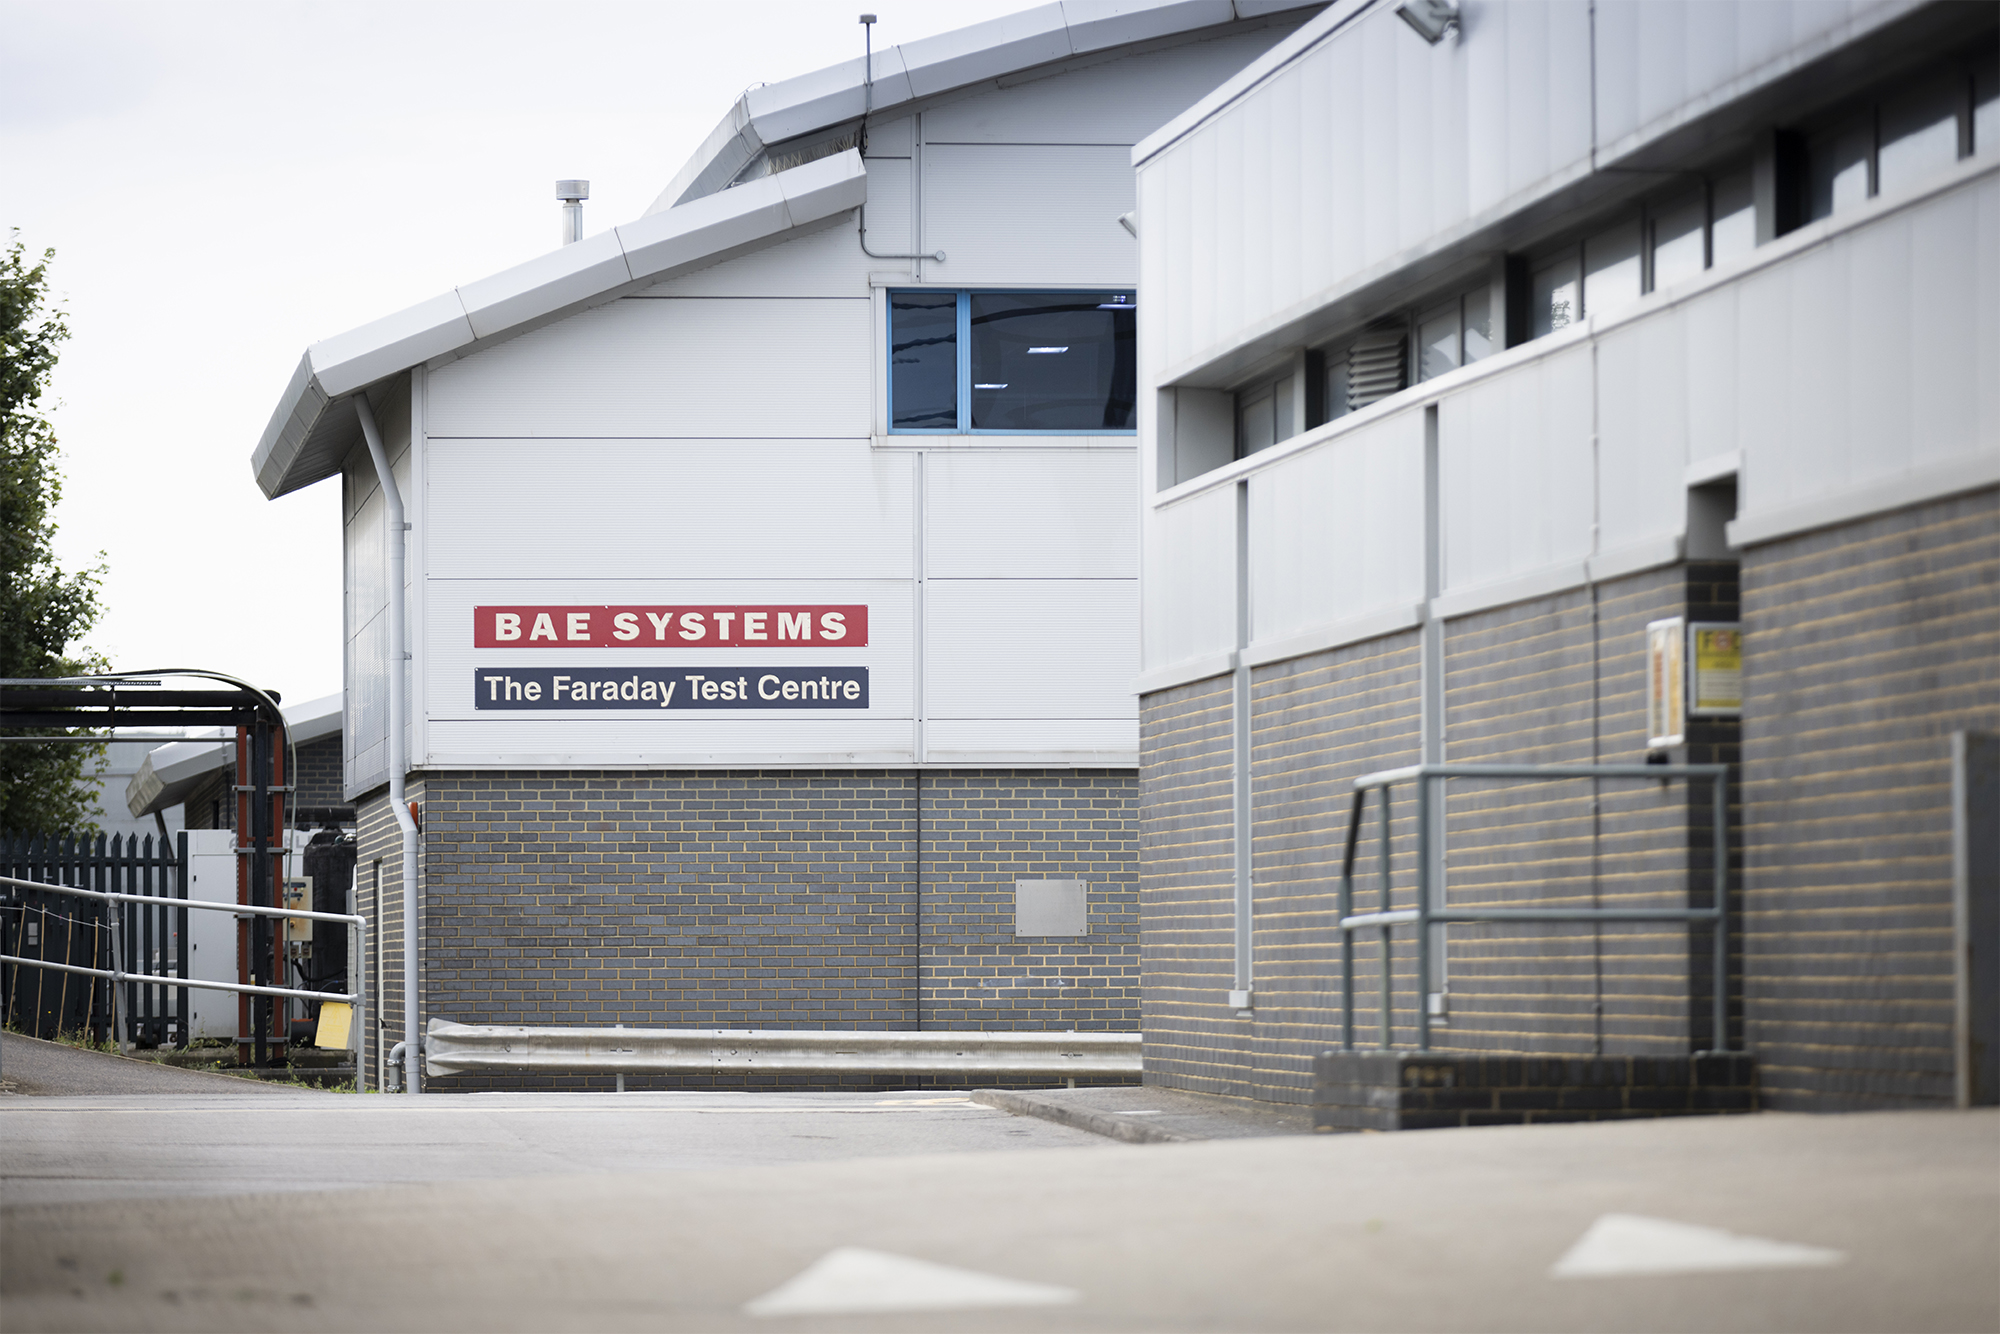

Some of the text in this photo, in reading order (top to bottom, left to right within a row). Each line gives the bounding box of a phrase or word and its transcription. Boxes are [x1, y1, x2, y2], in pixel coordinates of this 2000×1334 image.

[495, 611, 847, 641] BAE SYSTEMS
[483, 674, 861, 707] The Faraday Test Centre
